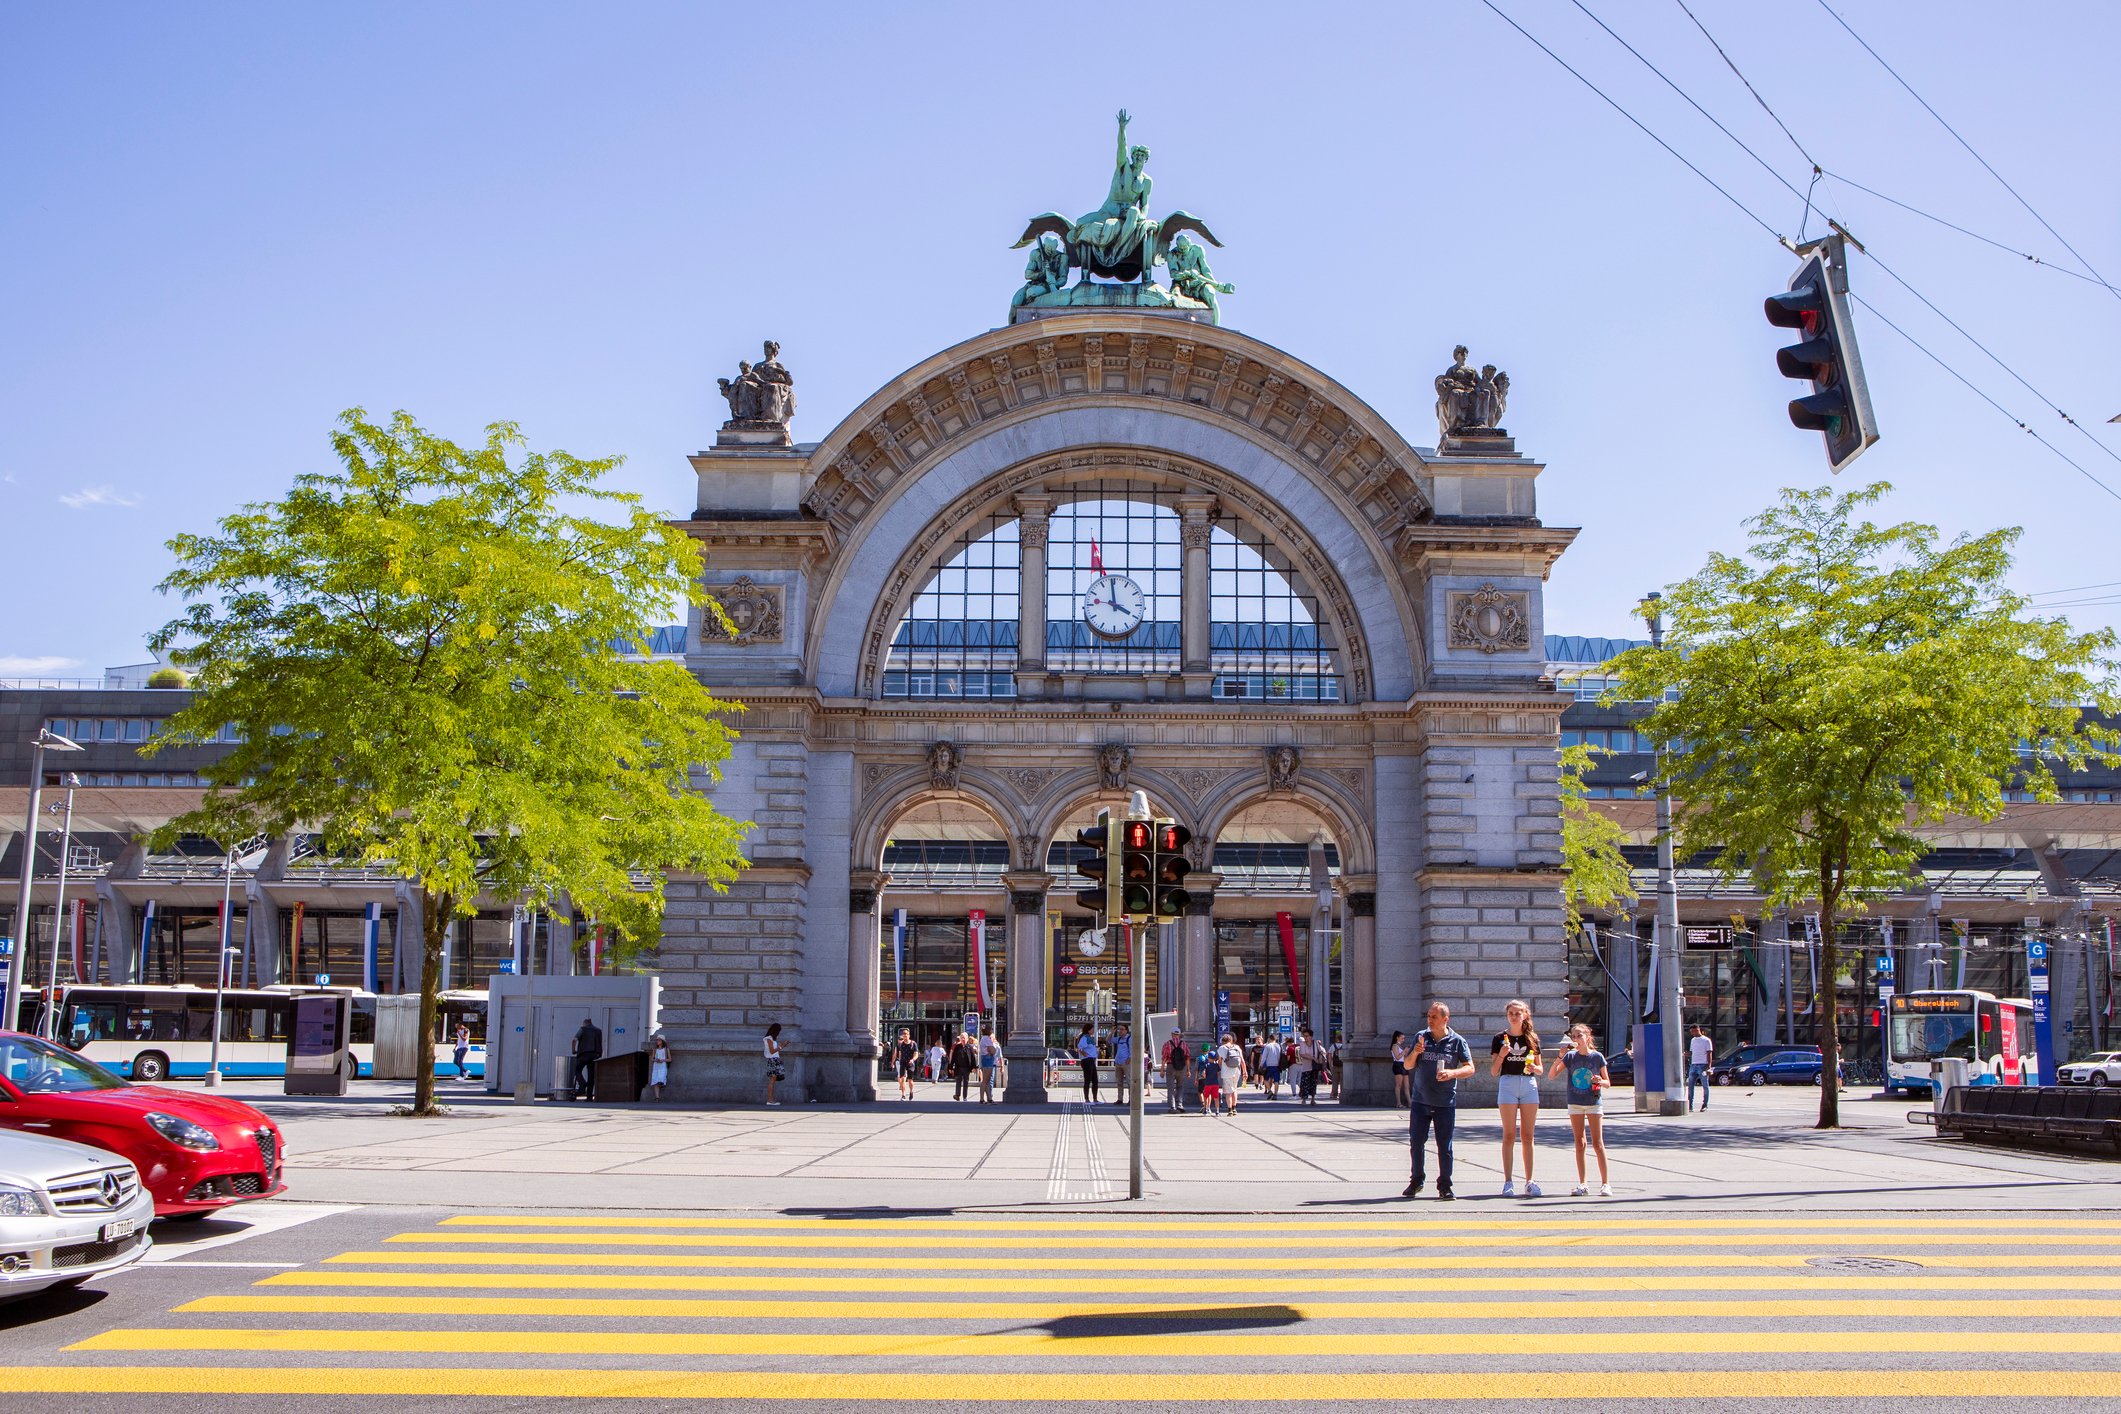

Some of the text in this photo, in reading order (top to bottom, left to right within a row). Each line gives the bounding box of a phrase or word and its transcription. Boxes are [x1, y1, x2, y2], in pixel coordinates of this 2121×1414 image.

[2032, 944, 2043, 956] G
[1880, 959, 1889, 968] H
[1078, 966, 1130, 975] SBB CFF FF
[1896, 999, 1905, 1008] 10
[2034, 998, 2043, 1006] 14
